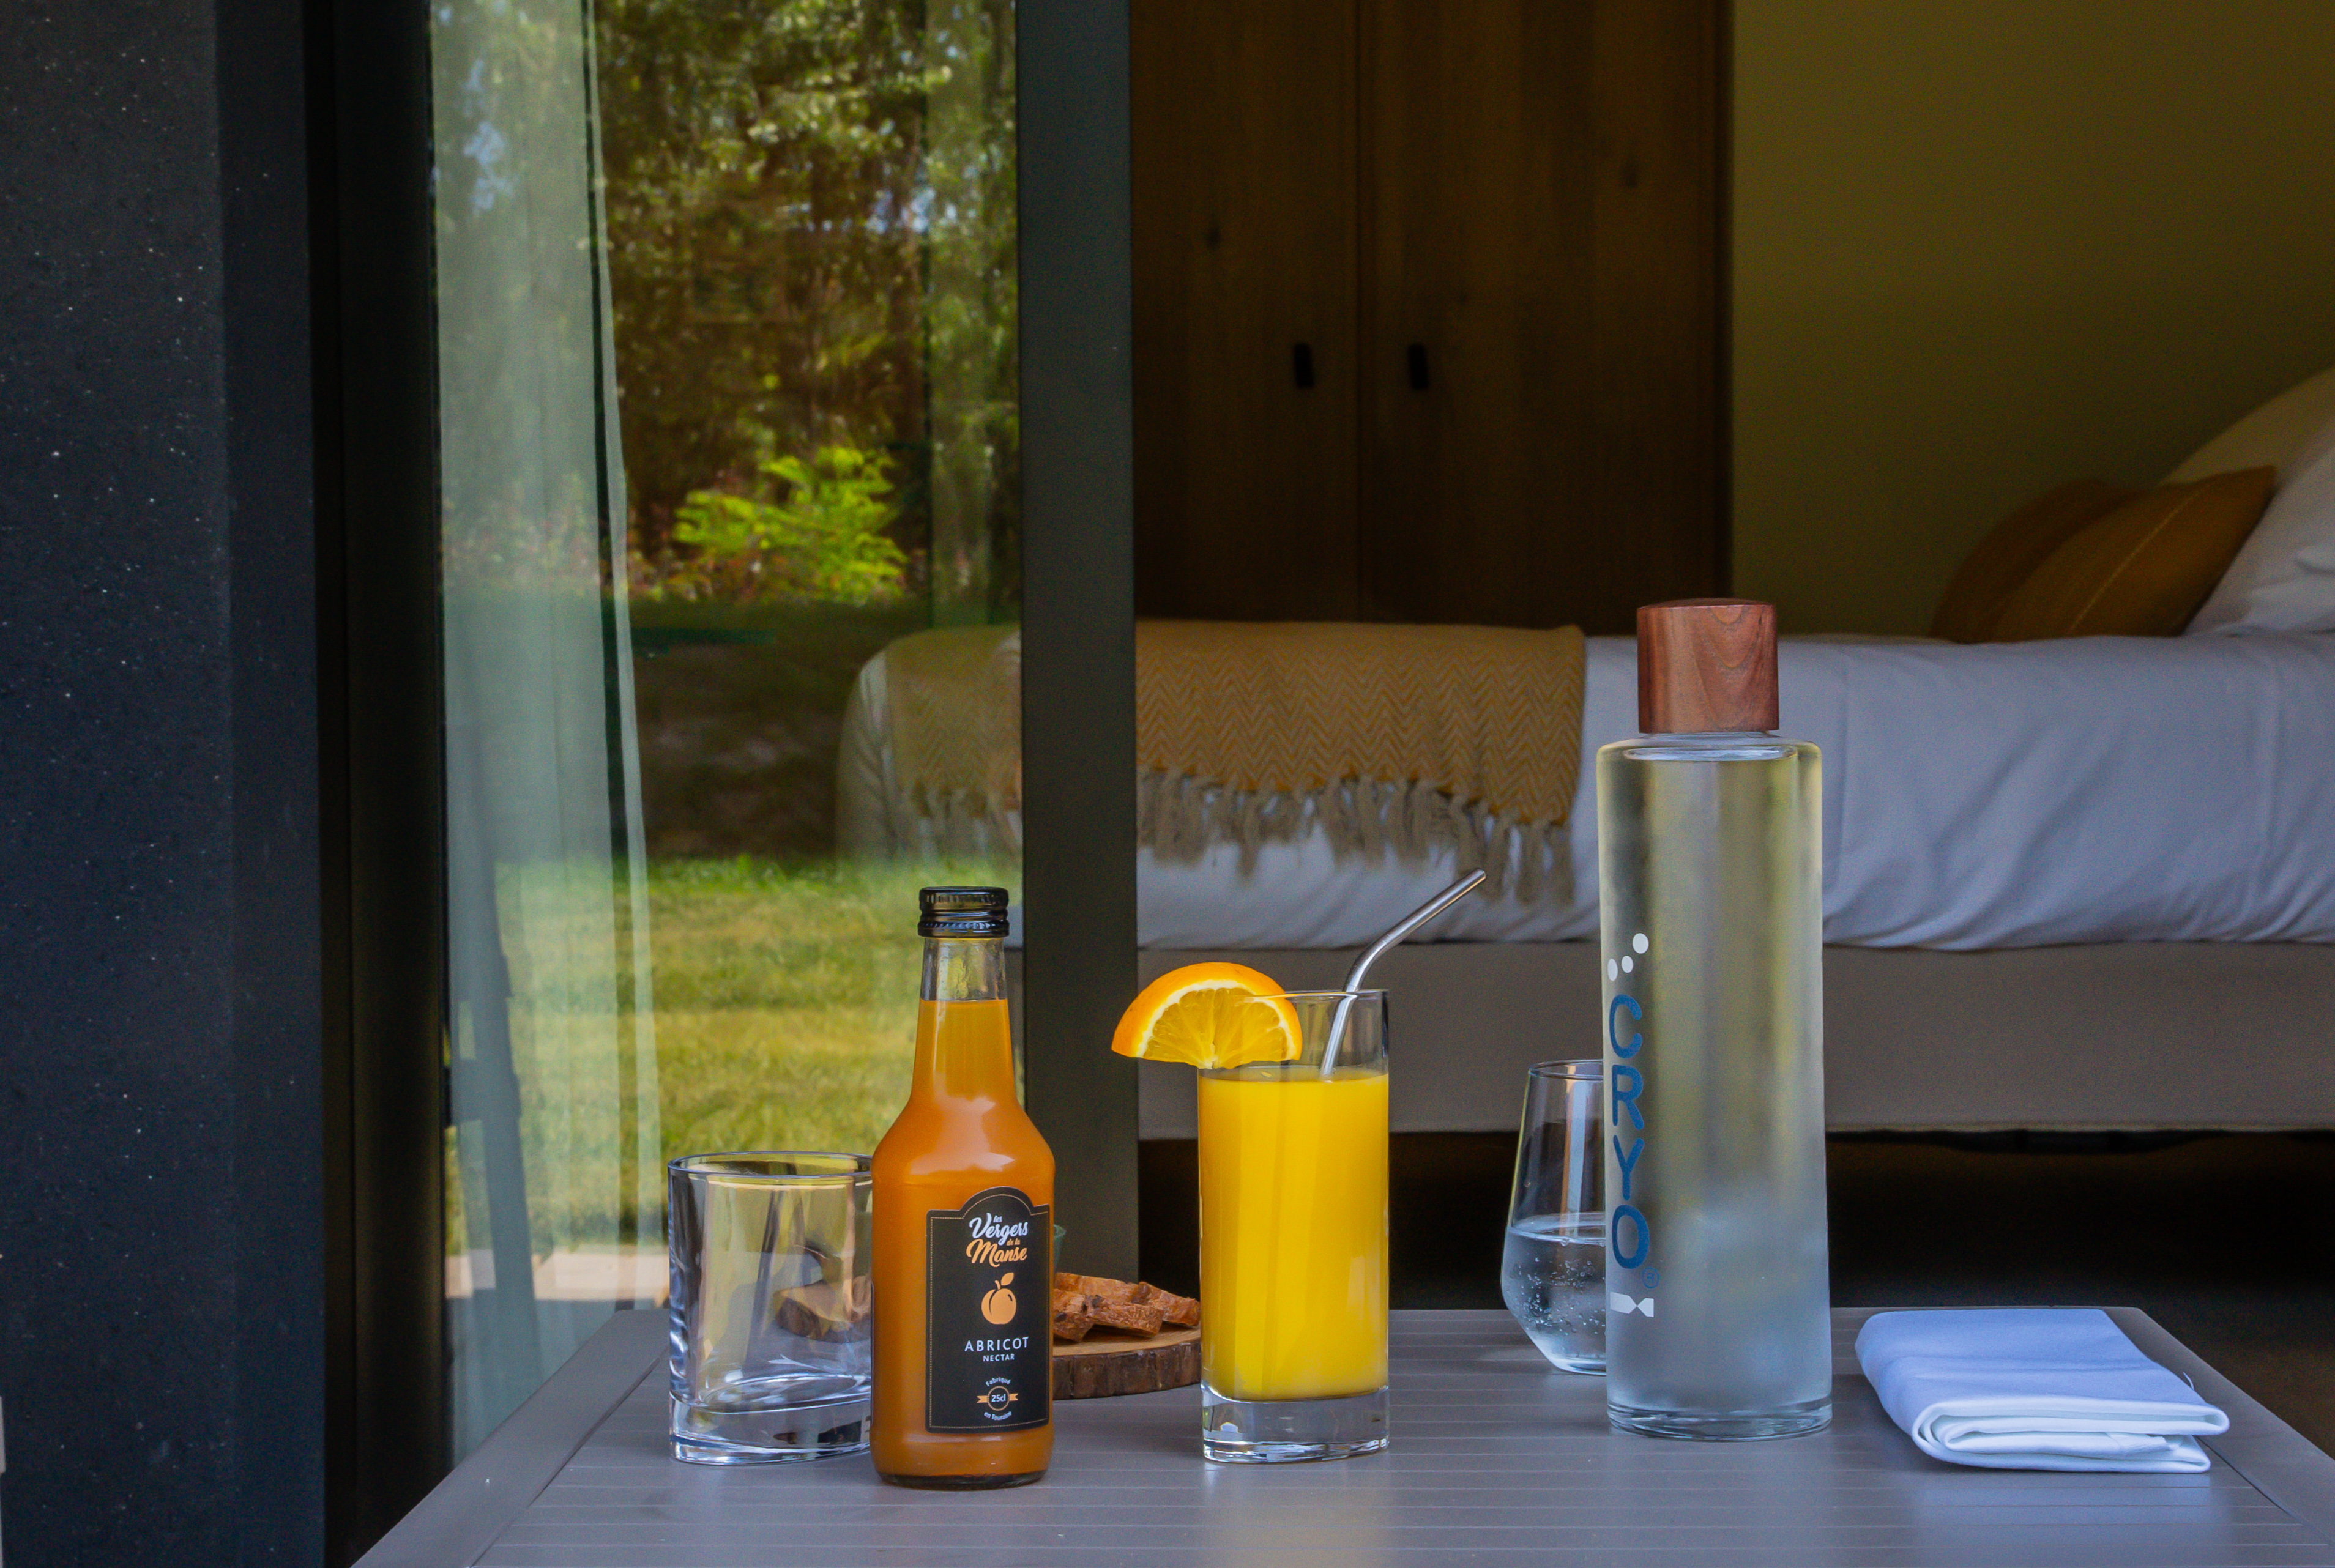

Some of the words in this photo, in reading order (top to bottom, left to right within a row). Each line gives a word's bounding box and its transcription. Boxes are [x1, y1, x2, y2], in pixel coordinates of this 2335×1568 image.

[1609, 994, 1650, 1270] CRYO
[969, 1213, 1028, 1246] Vergers
[966, 1238, 1027, 1268] Manse
[964, 1336, 1029, 1351] ABRICOT
[983, 1353, 1015, 1362] NECTAR
[991, 1394, 1006, 1402] 25cl
